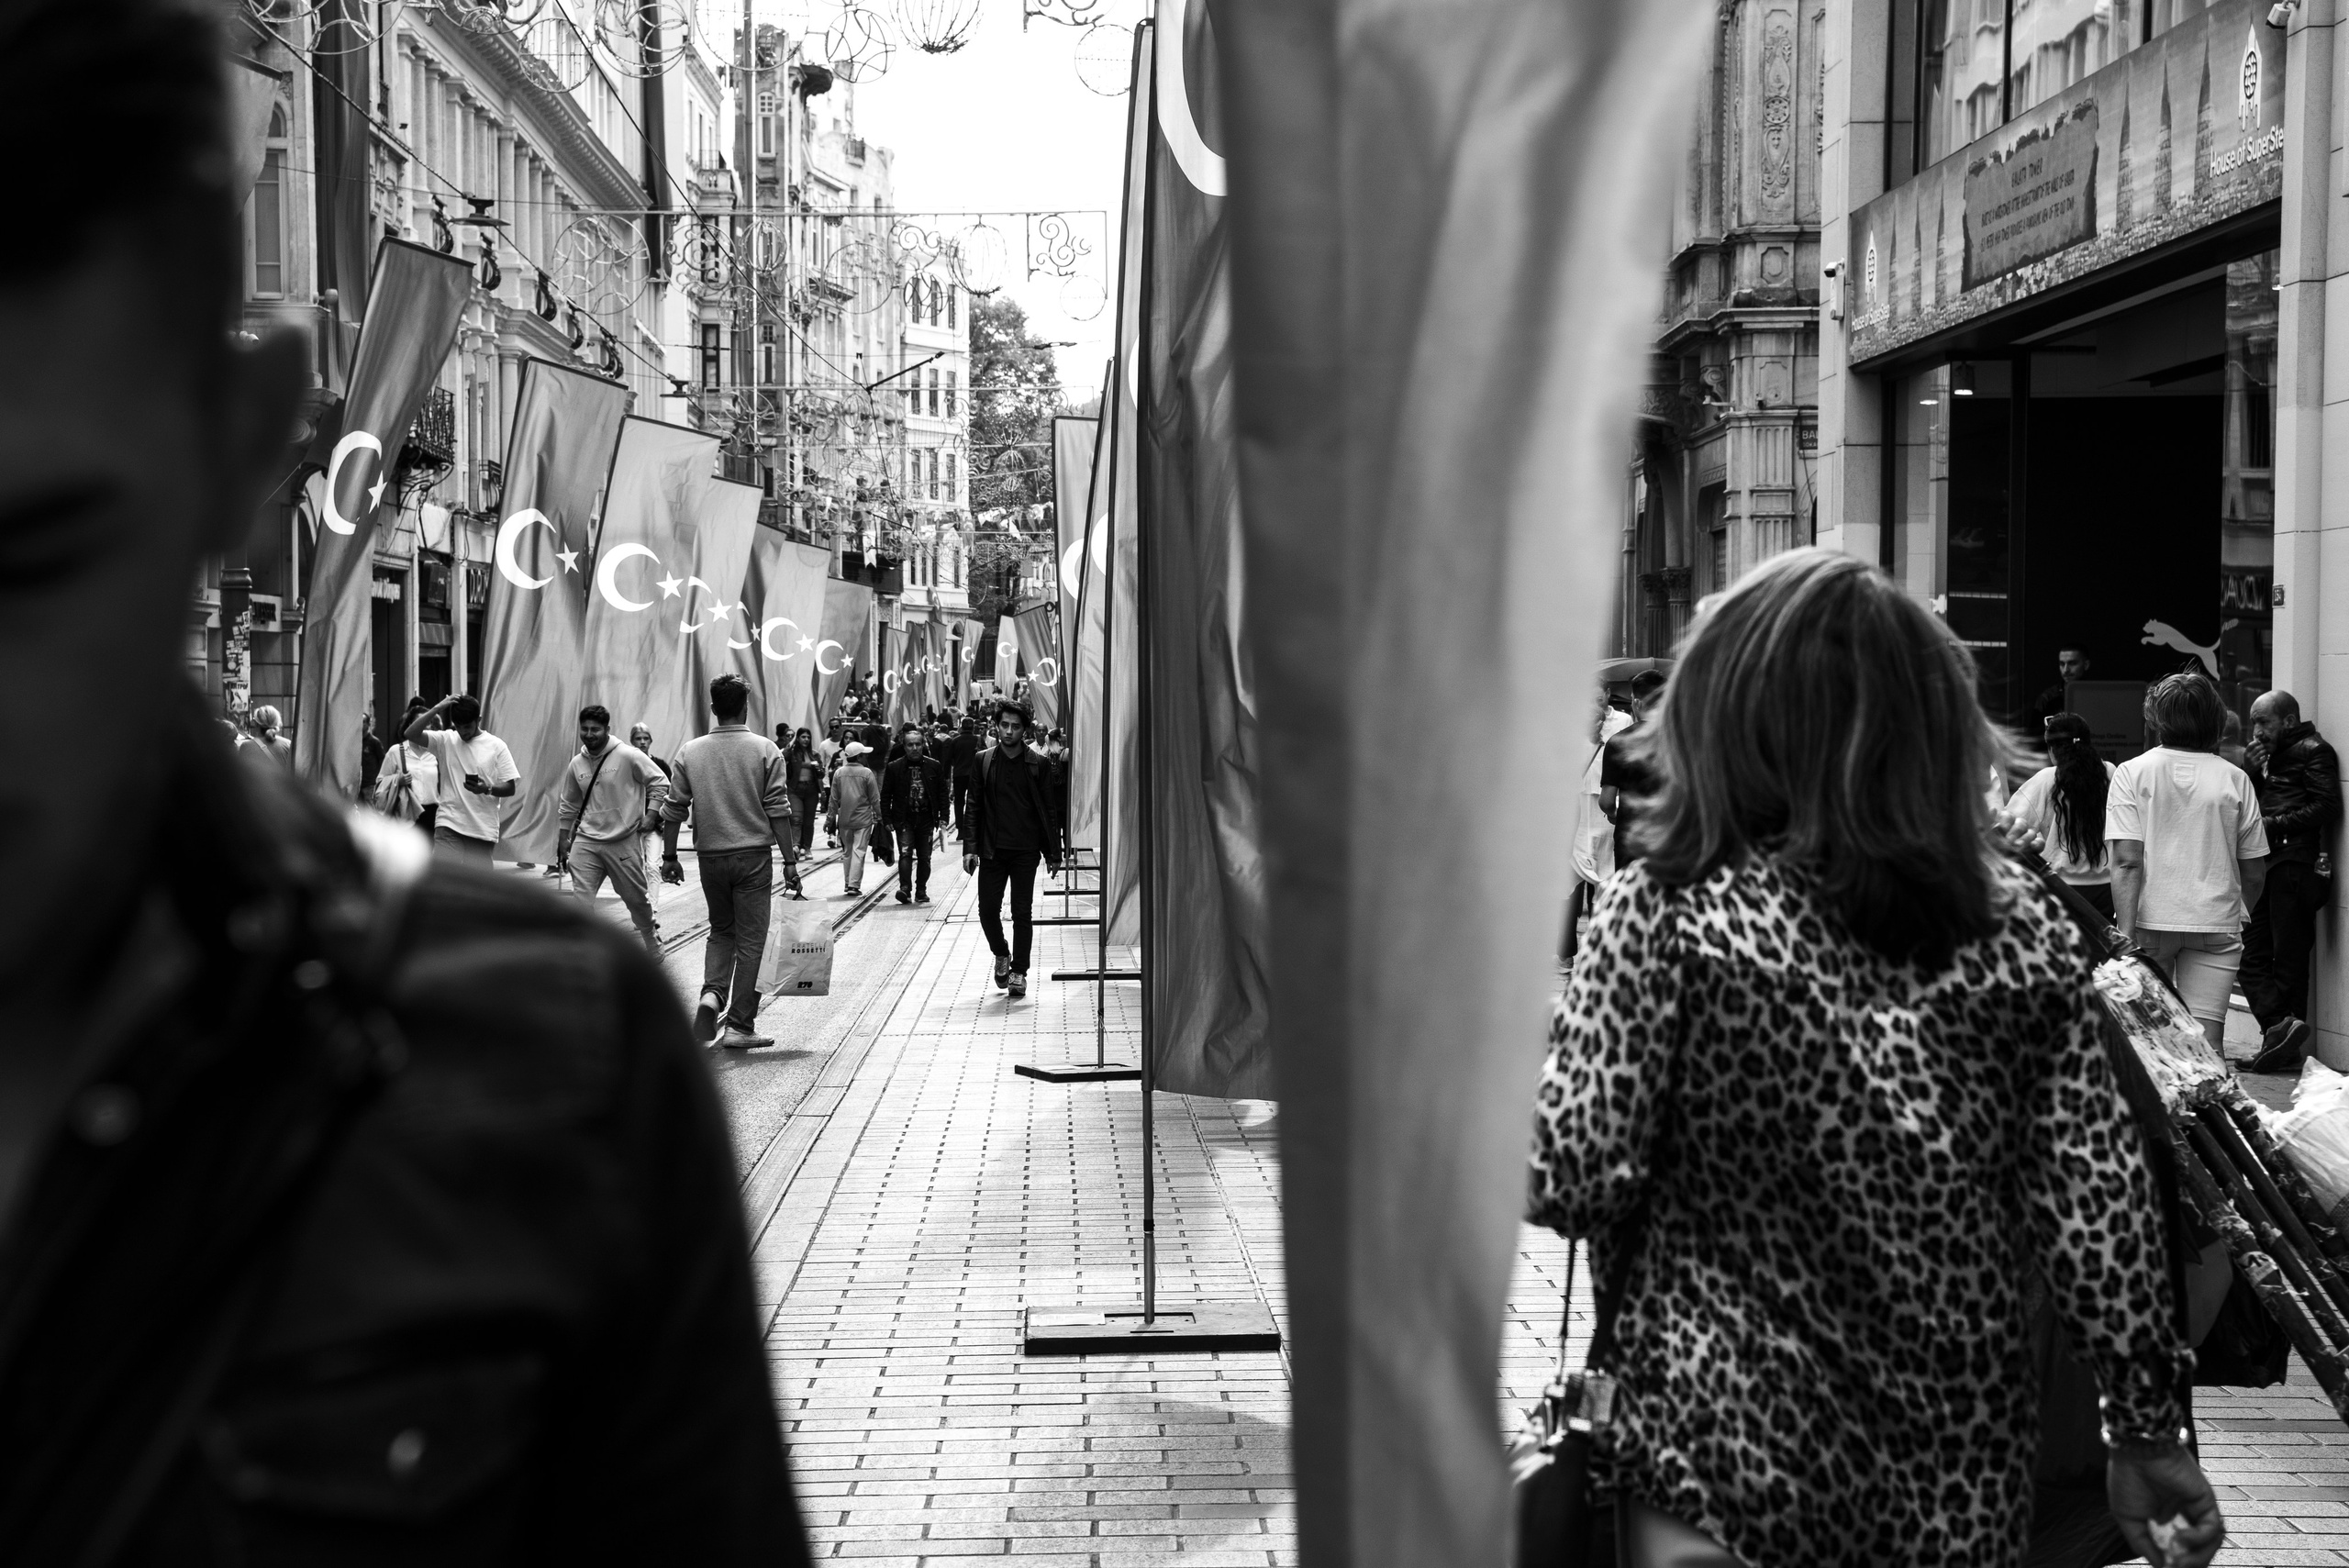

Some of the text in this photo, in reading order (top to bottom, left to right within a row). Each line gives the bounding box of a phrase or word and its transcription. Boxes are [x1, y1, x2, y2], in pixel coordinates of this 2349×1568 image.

[2210, 124, 2284, 178] House of SuperSte
